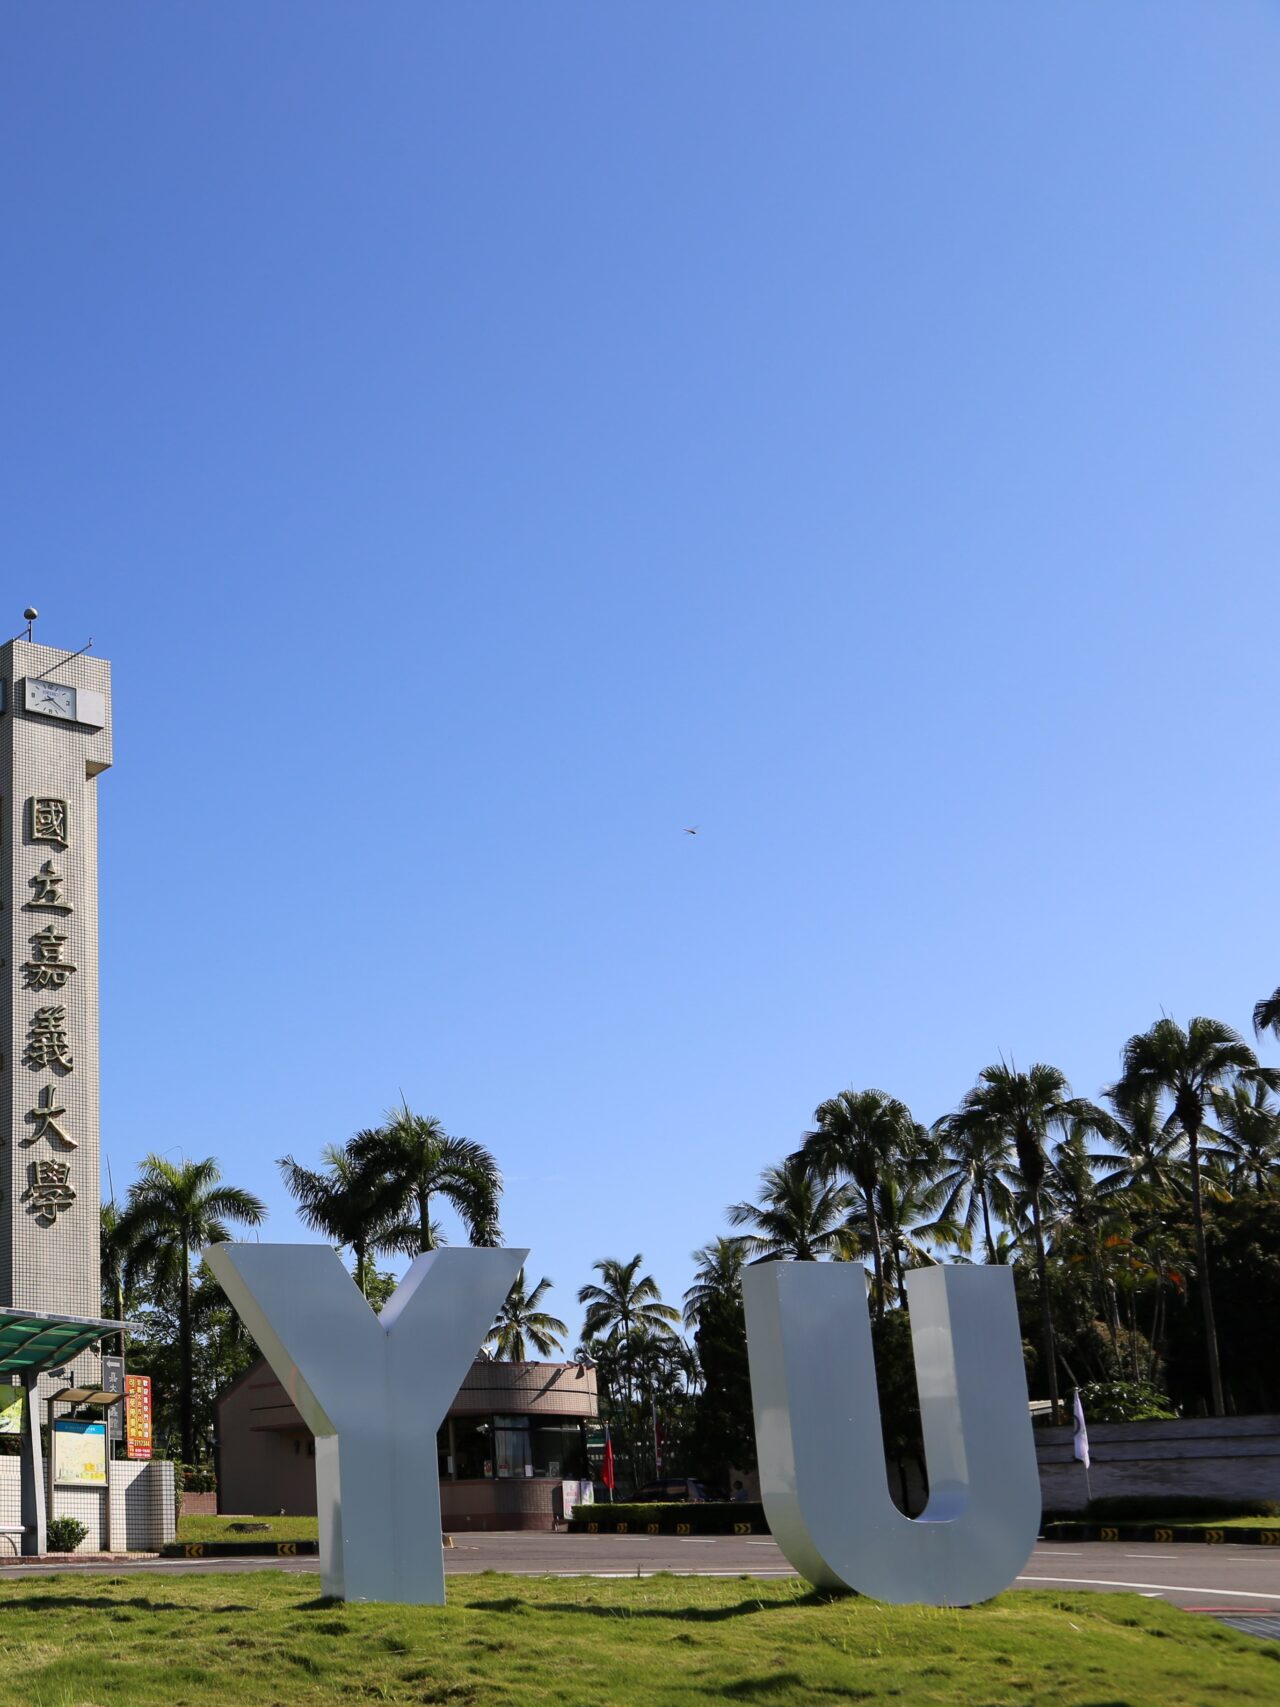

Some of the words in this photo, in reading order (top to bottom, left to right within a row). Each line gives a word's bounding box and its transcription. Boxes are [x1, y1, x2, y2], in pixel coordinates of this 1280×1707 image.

[19, 796, 78, 1222] 國立嘉義大學
